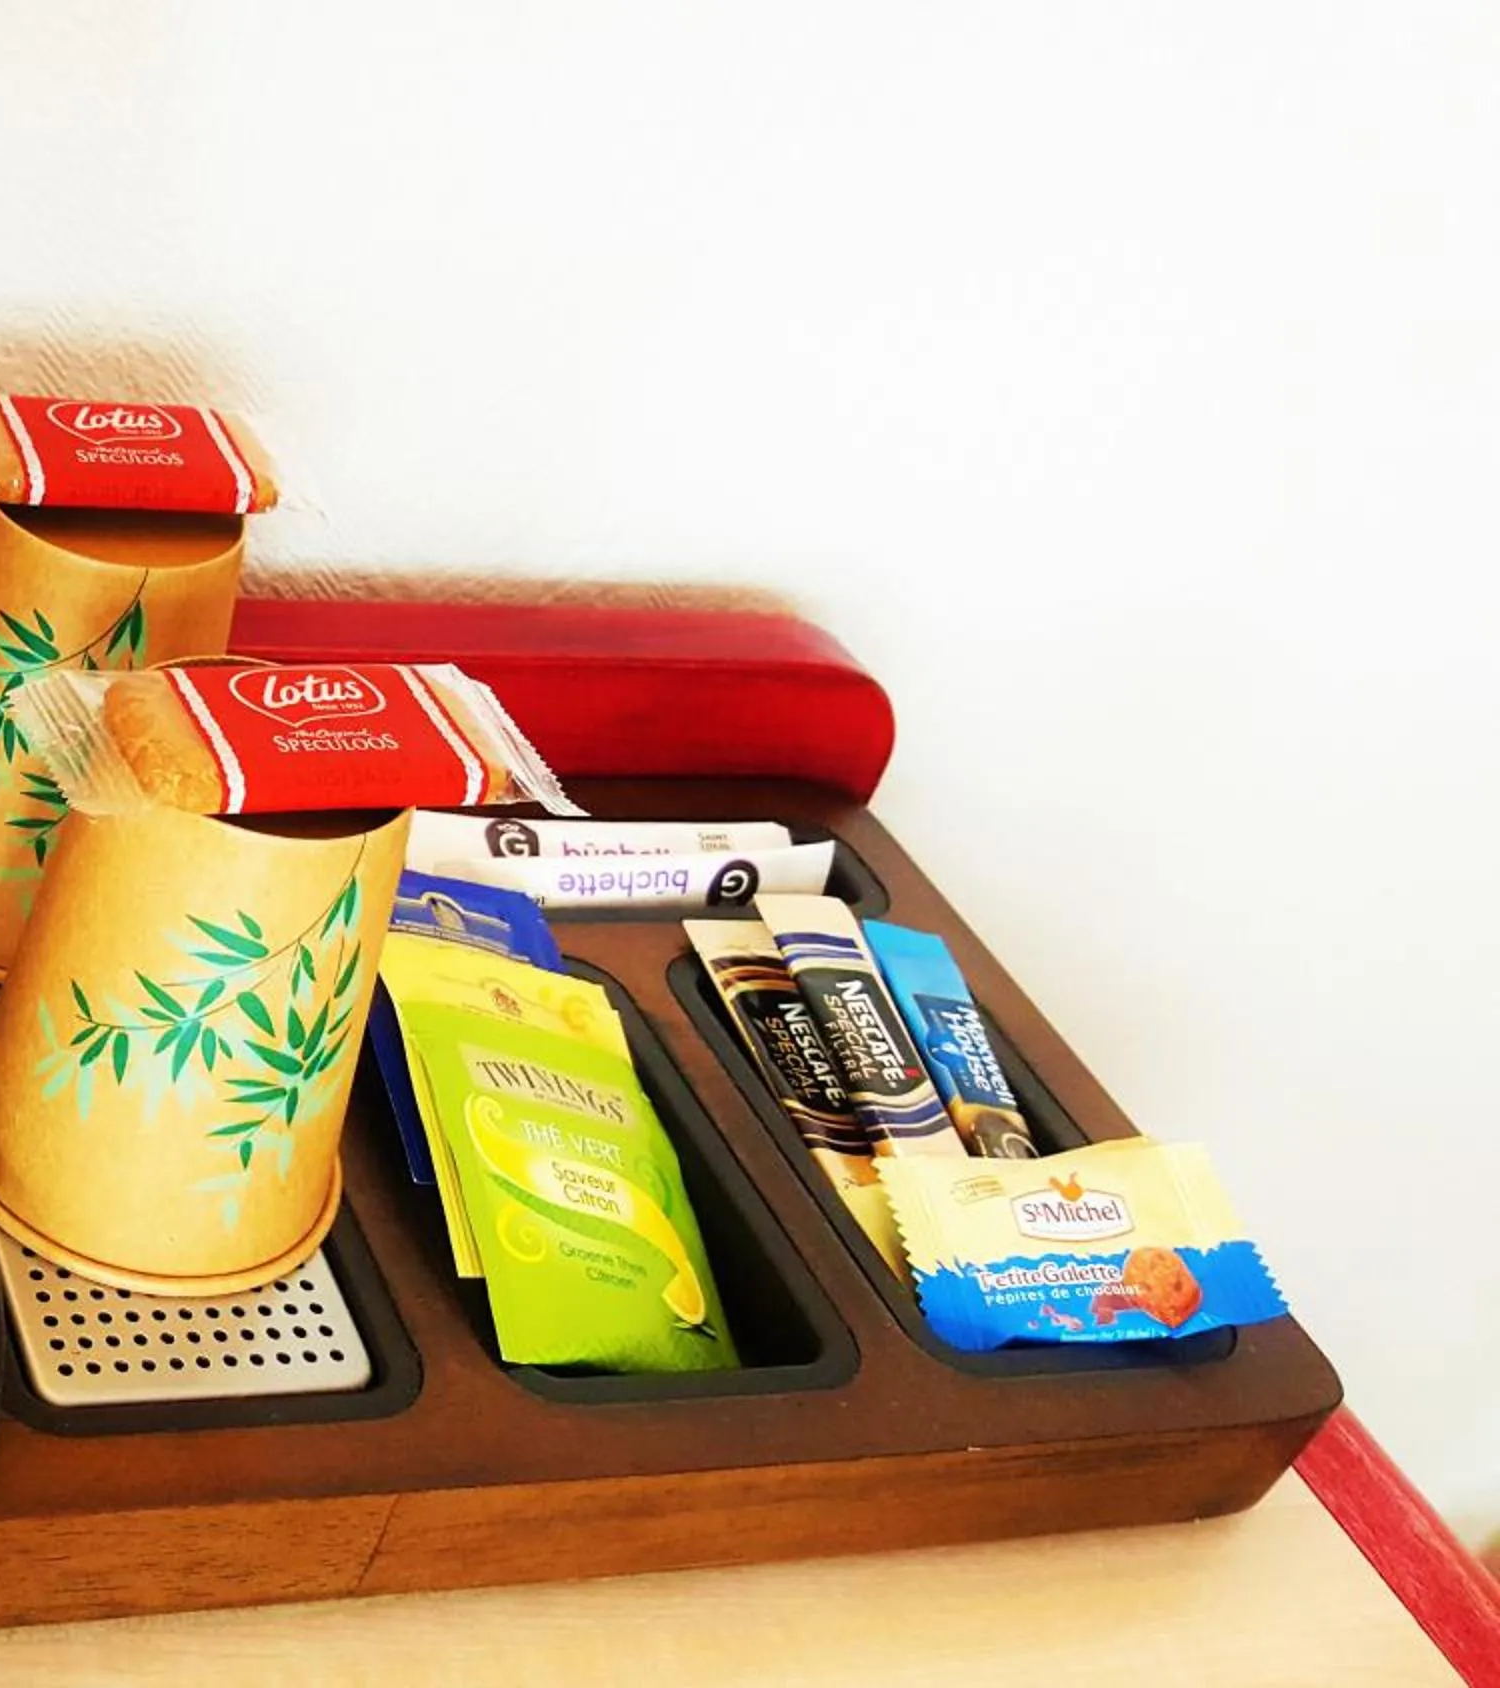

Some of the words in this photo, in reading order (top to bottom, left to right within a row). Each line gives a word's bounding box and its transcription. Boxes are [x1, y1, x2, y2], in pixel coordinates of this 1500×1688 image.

[74, 406, 163, 430] Lotus
[263, 674, 364, 709] Lotus
[273, 733, 399, 753] SPECULOOS
[940, 1010, 992, 1092] House
[956, 1005, 1018, 1107] Maxwell
[476, 1061, 624, 1124] TWININGS
[568, 1132, 624, 1167] VERT
[551, 1161, 616, 1193] Saveur
[563, 1184, 621, 1215] Citron
[1051, 1287, 1071, 1299] de
